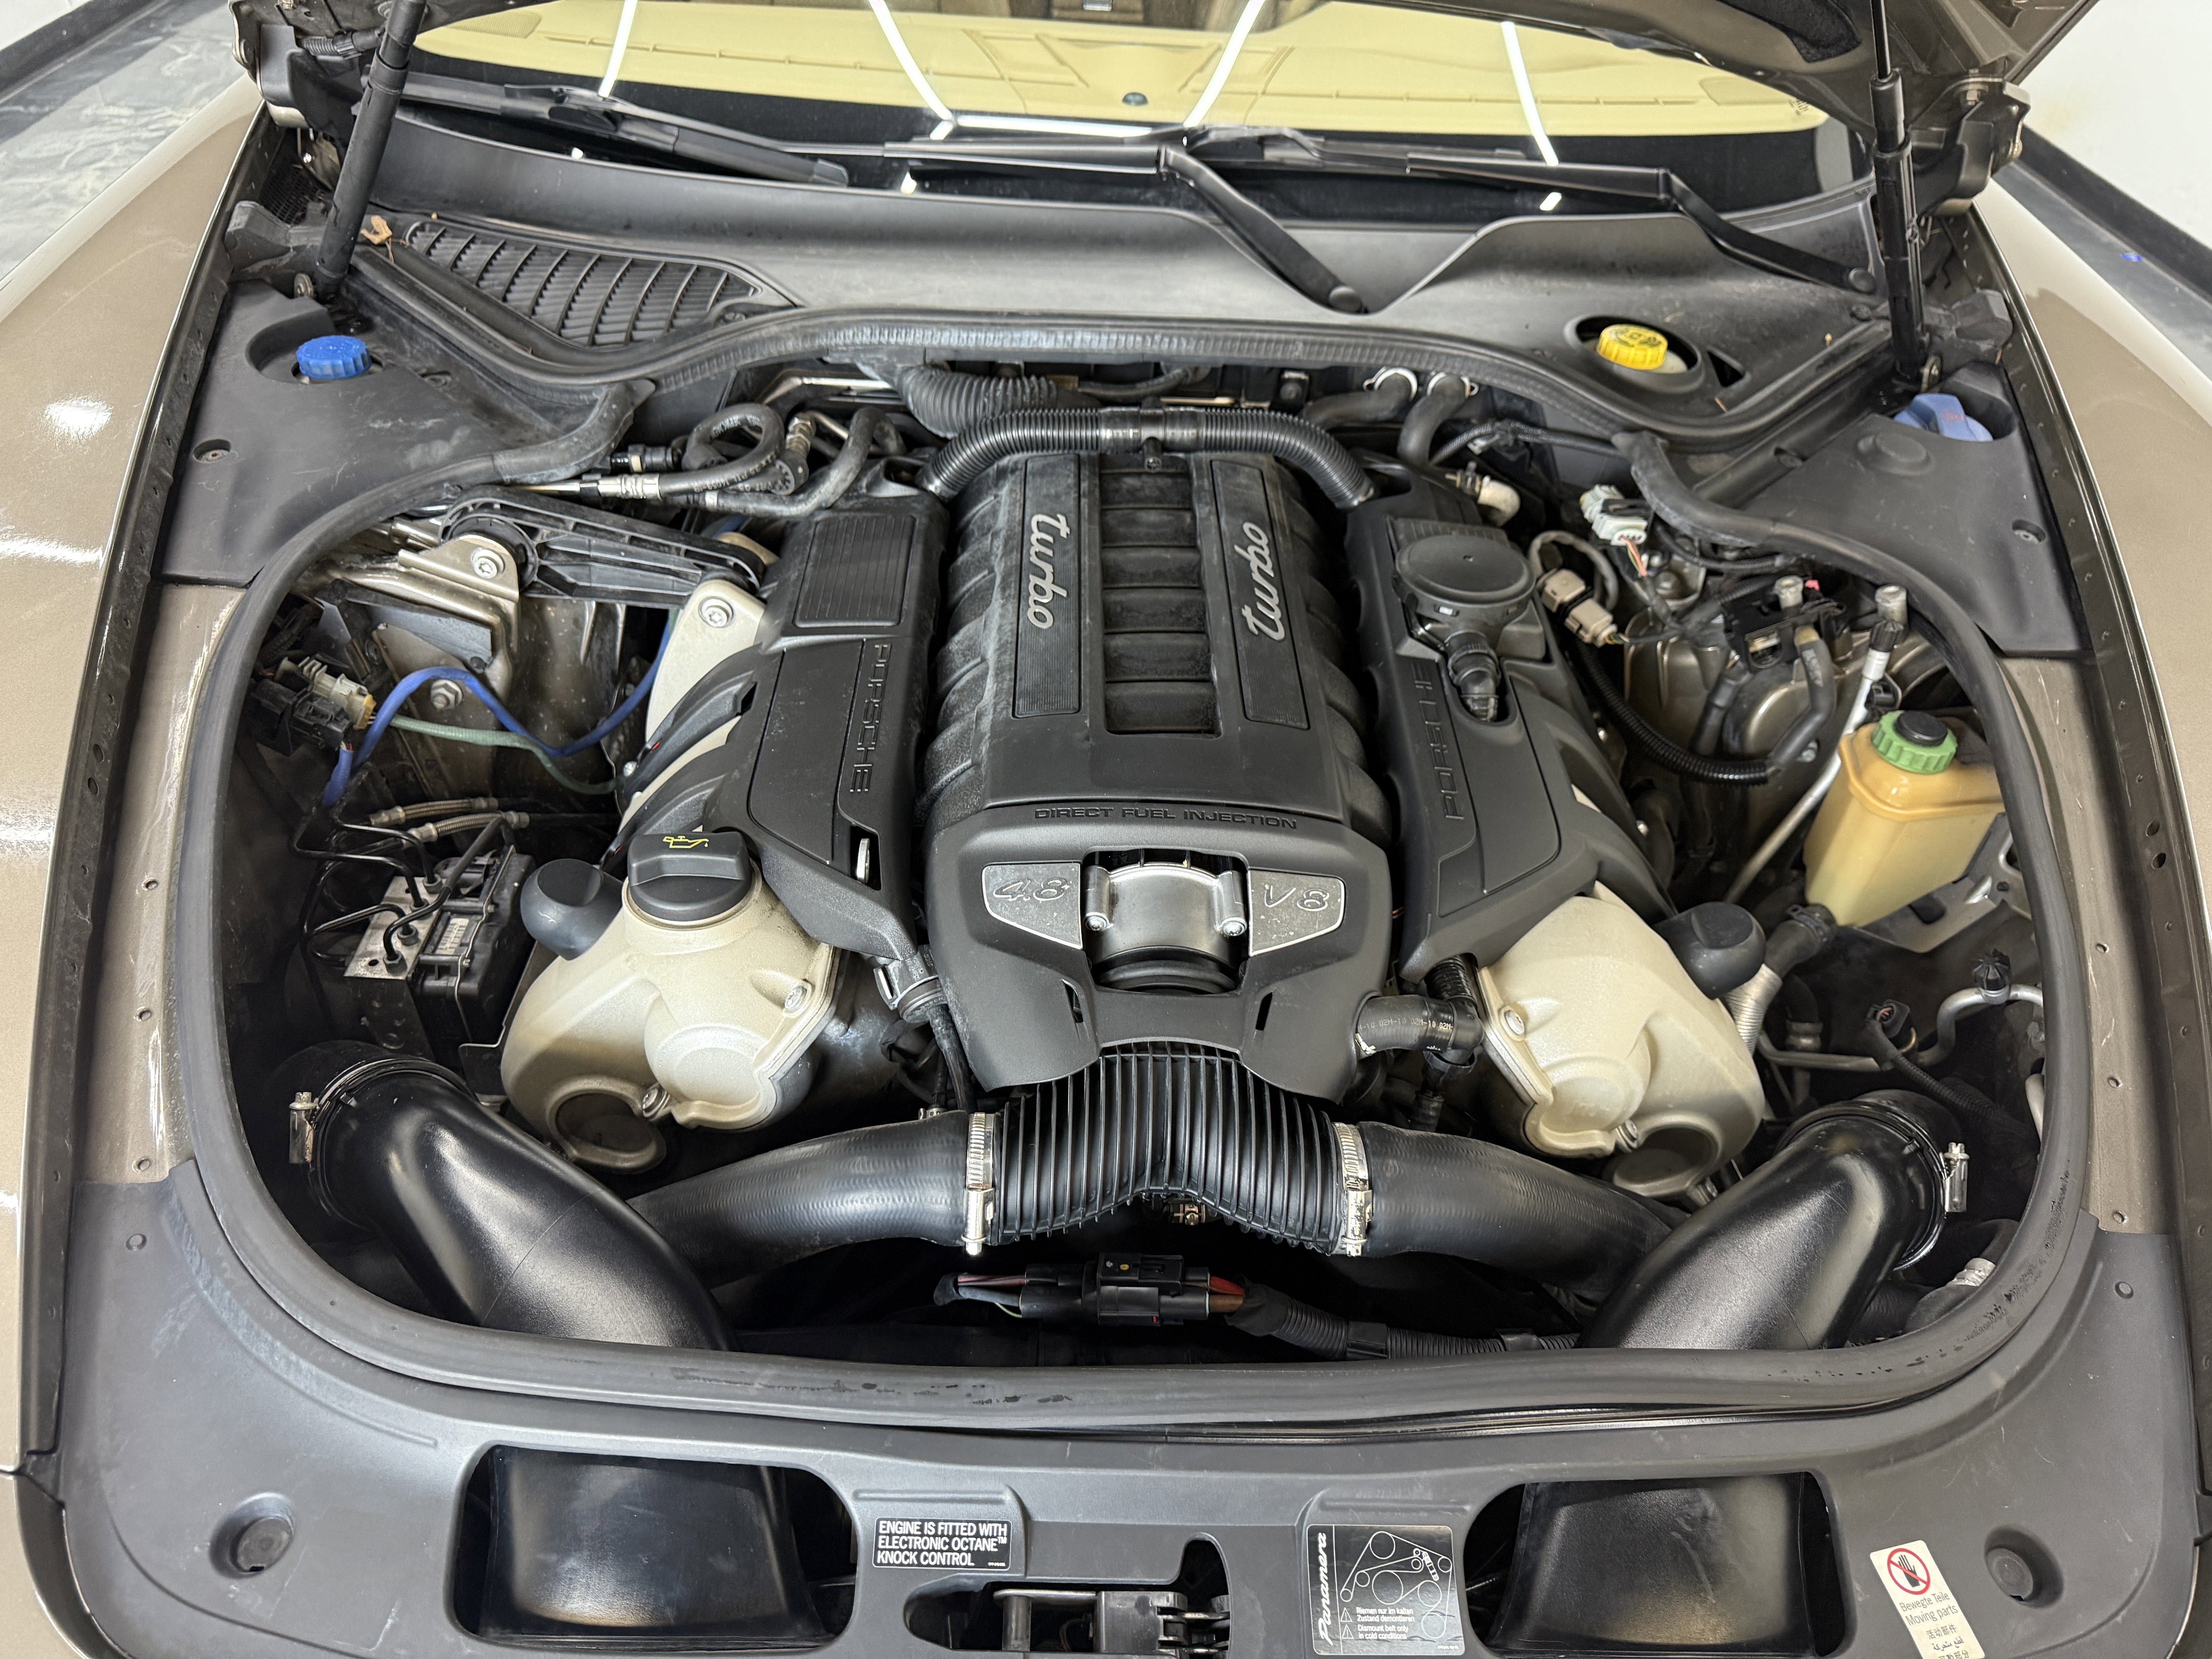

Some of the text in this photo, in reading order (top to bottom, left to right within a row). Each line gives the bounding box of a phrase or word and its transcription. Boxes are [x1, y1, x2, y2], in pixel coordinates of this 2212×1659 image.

[1027, 513, 1070, 629] turbo
[1234, 522, 1285, 641] turbo
[850, 644, 892, 792] PORSCHE
[1411, 661, 1464, 820] PORSCHE
[1035, 807, 1297, 830] DIRECT FUEL INJECTION
[993, 878, 1068, 902] 4.8
[1264, 884, 1329, 912] V8
[879, 1520, 1008, 1537] ENGINE IS FITTED WITH
[878, 1535, 949, 1551] ELECTRONIC
[877, 1551, 975, 1566] KNOCK CONTROL
[1318, 1532, 1333, 1645] Panamera
[1899, 1592, 1950, 1612] Bewegte Teile
[1905, 1605, 1958, 1626] Moving parts
[1926, 1624, 1957, 1640] 活动部件
